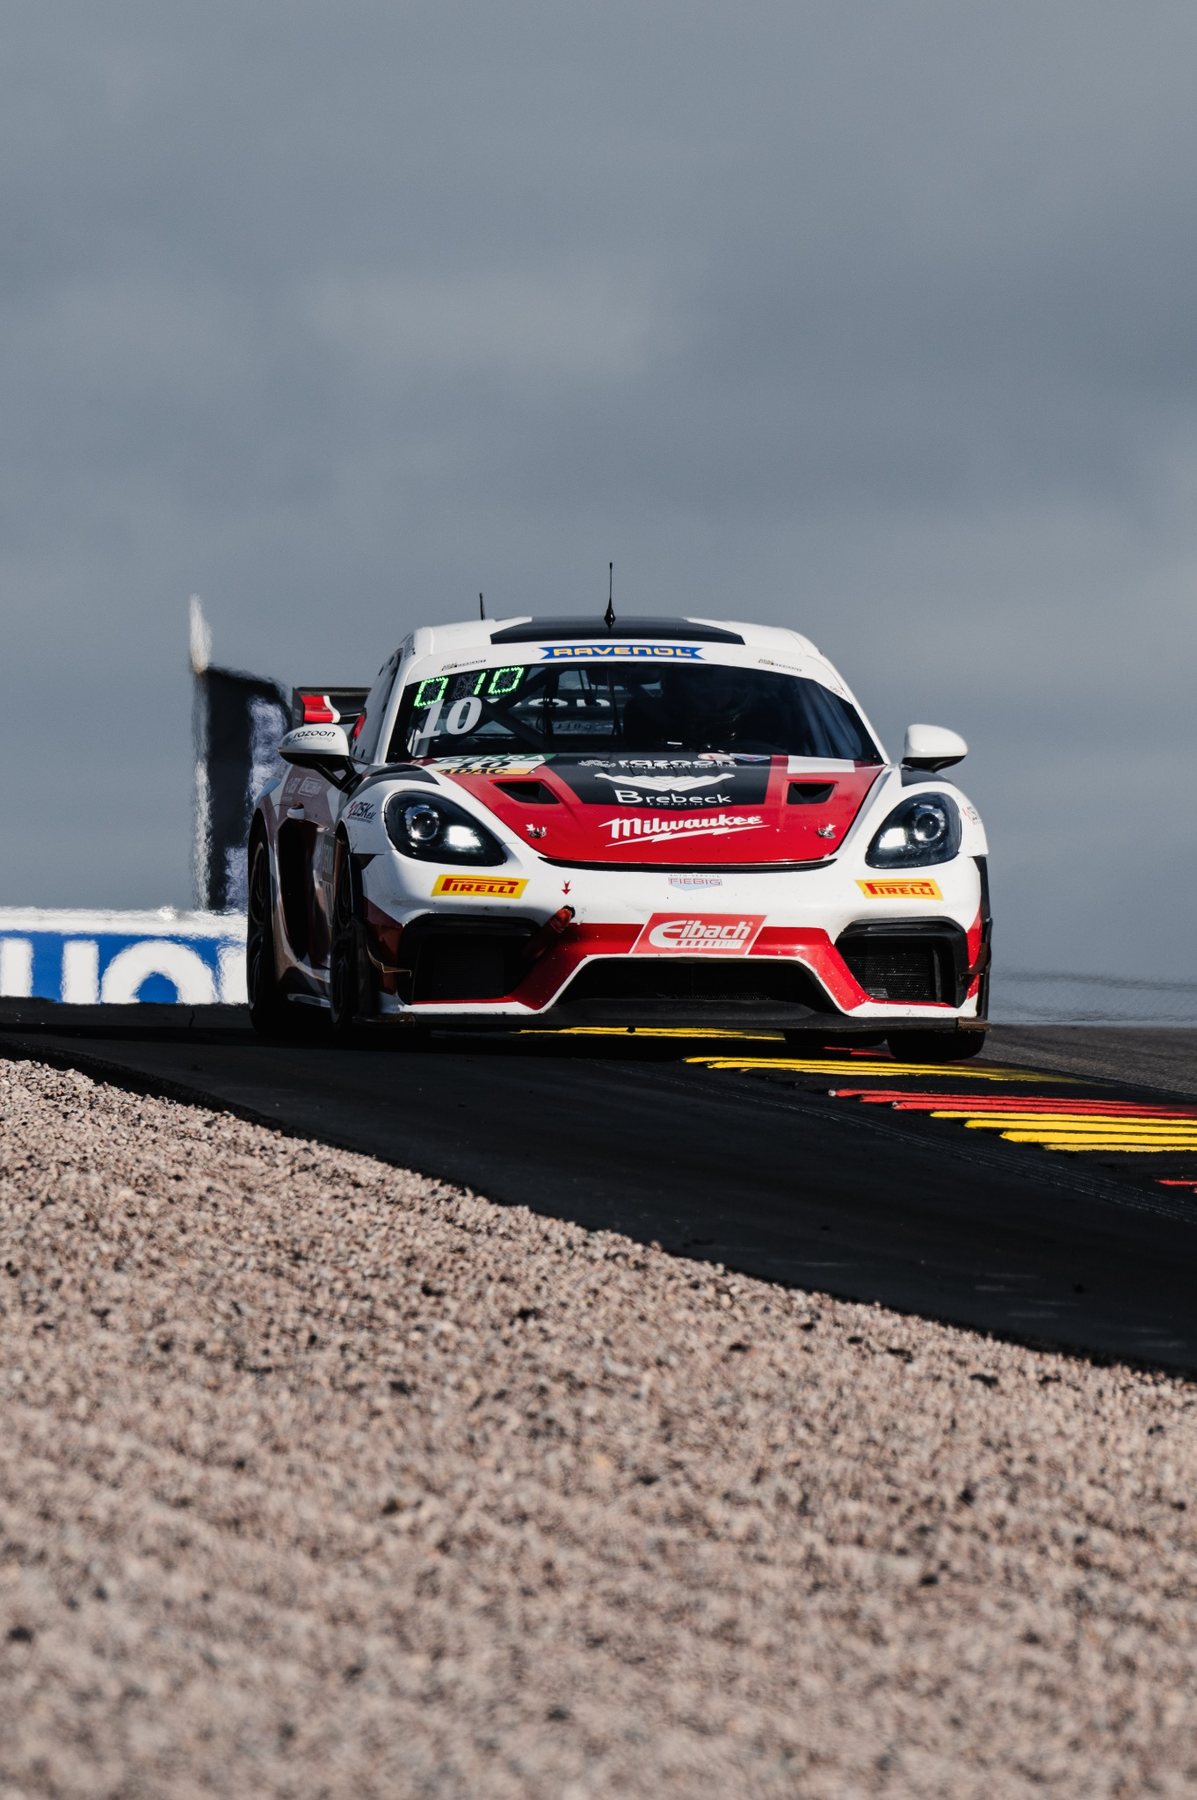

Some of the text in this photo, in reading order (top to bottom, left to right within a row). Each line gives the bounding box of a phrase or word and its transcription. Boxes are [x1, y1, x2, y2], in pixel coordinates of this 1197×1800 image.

[553, 646, 692, 657] RAVENOL
[414, 696, 482, 742] 10
[293, 730, 336, 739] razoon
[458, 761, 512, 769] 10
[614, 789, 732, 804] Brebeck
[598, 813, 763, 839] Milwaukee
[441, 878, 519, 894] PIRELLI
[864, 881, 935, 896] PIRELLI
[648, 919, 752, 950] Eibach
